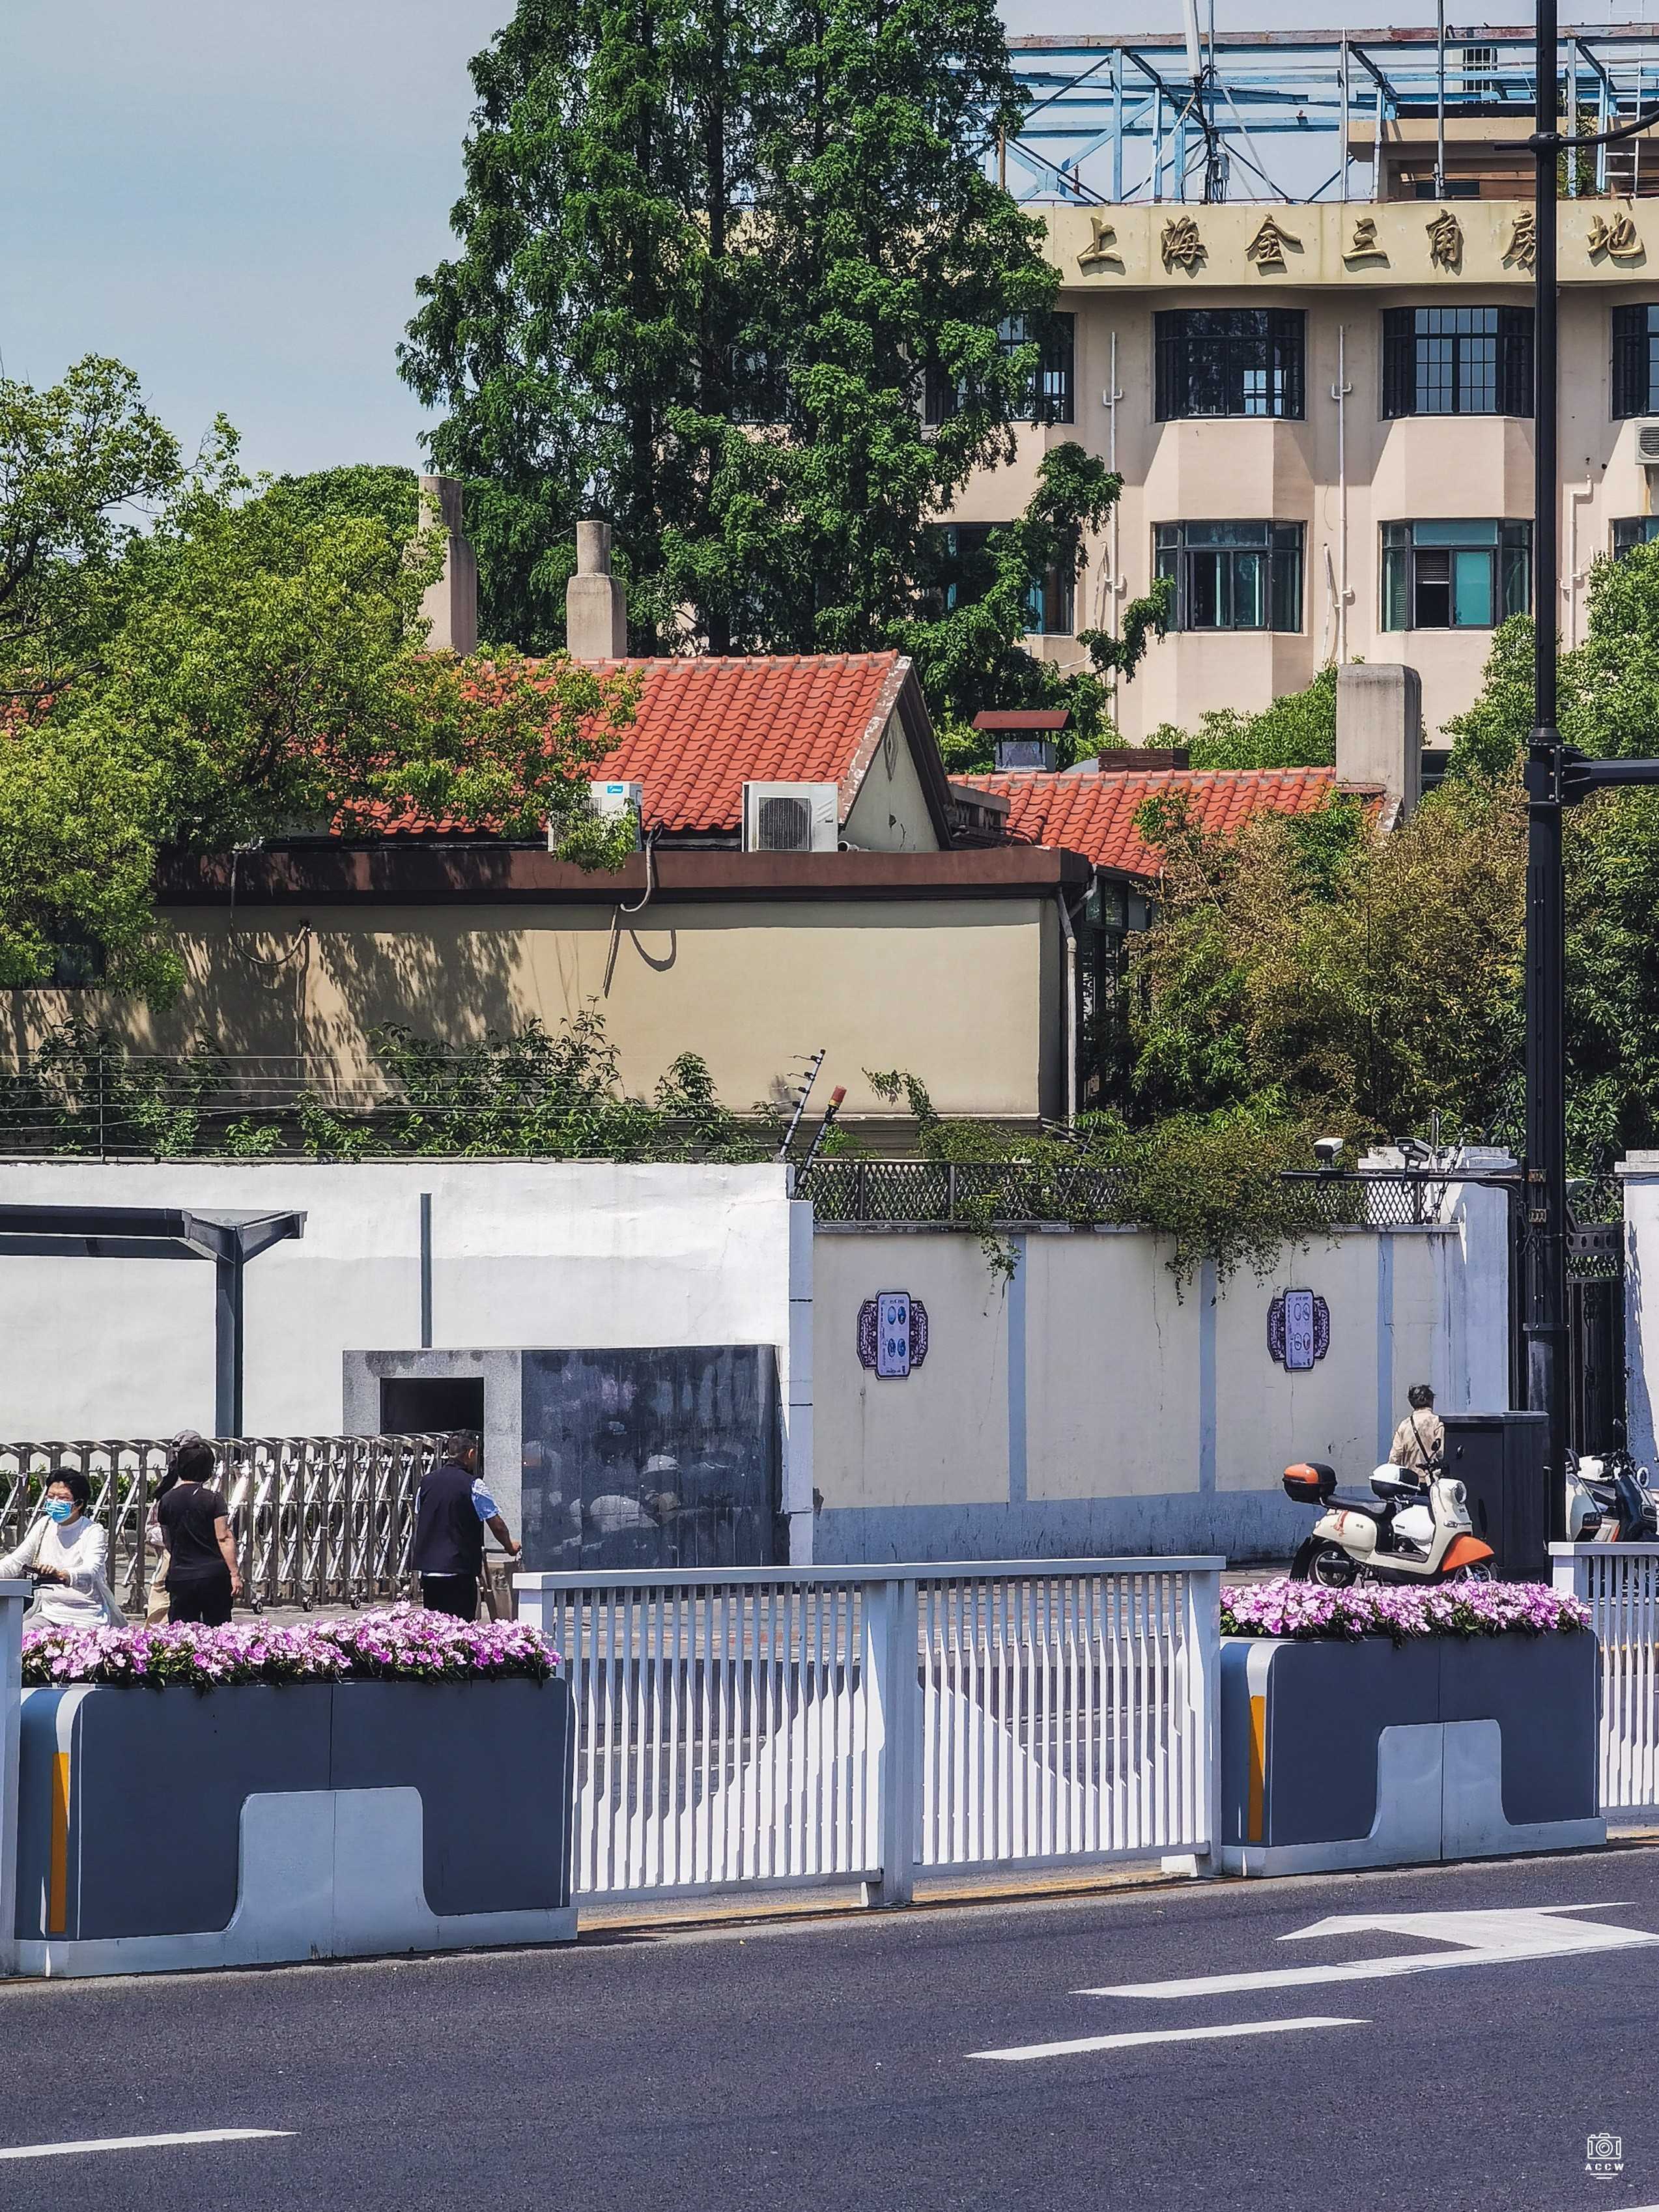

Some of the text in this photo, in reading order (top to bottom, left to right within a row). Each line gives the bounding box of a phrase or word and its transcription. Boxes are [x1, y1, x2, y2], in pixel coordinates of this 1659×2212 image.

[1077, 210, 1644, 268] 上海金三角房地
